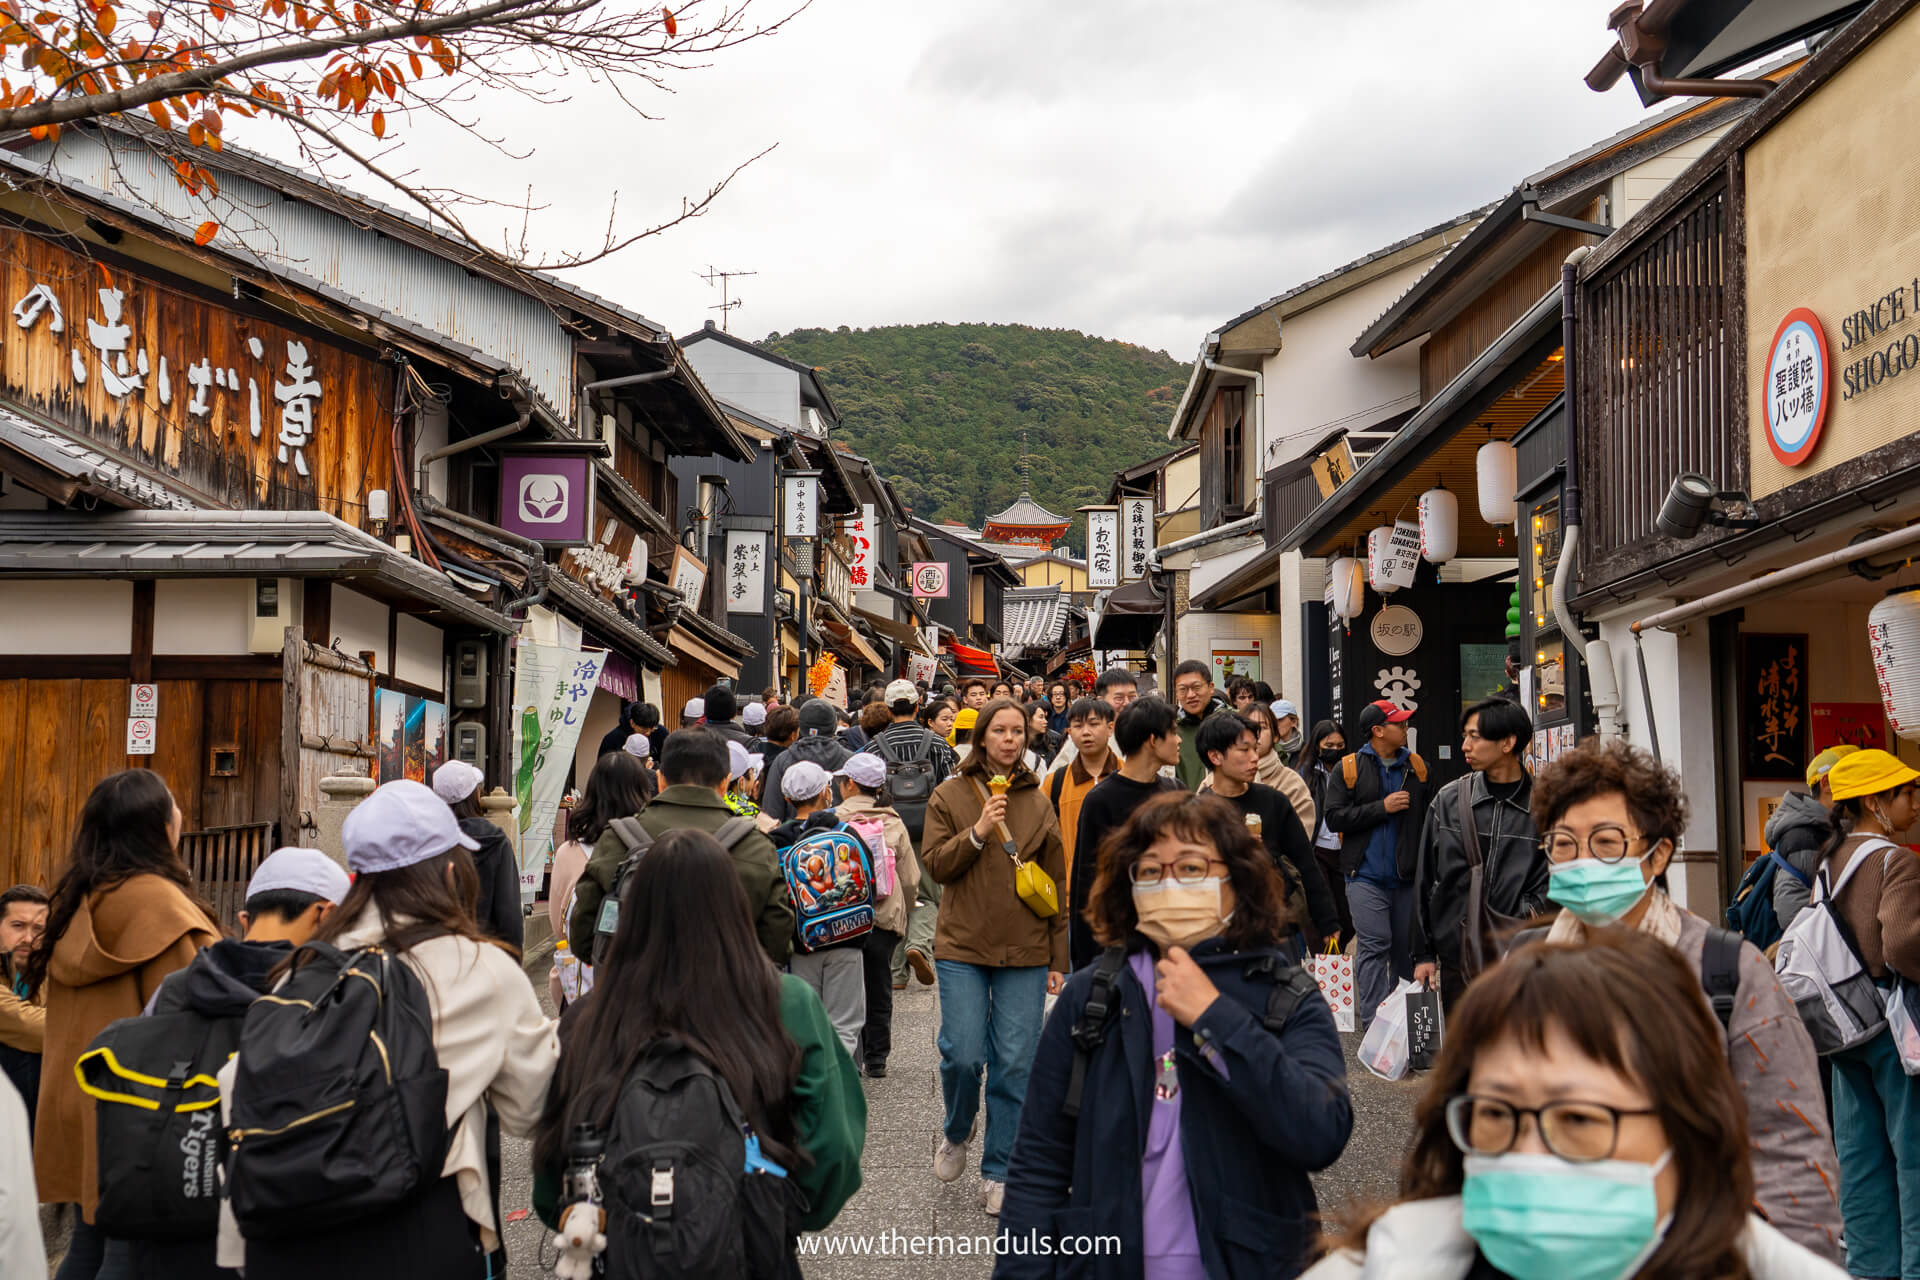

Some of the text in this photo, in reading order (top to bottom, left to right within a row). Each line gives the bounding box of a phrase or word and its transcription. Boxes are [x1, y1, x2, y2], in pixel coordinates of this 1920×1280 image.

[1841, 286, 1905, 352] SINCE
[1775, 354, 1814, 400] 聖護院
[1843, 328, 1920, 401] SHOGO
[924, 569, 937, 590] 西尾
[1377, 623, 1418, 637] 坂の駅
[563, 659, 599, 726] 冷やし
[534, 681, 569, 773] きゅうり
[831, 911, 871, 937] MARVEL
[180, 1110, 216, 1199] Tigers
